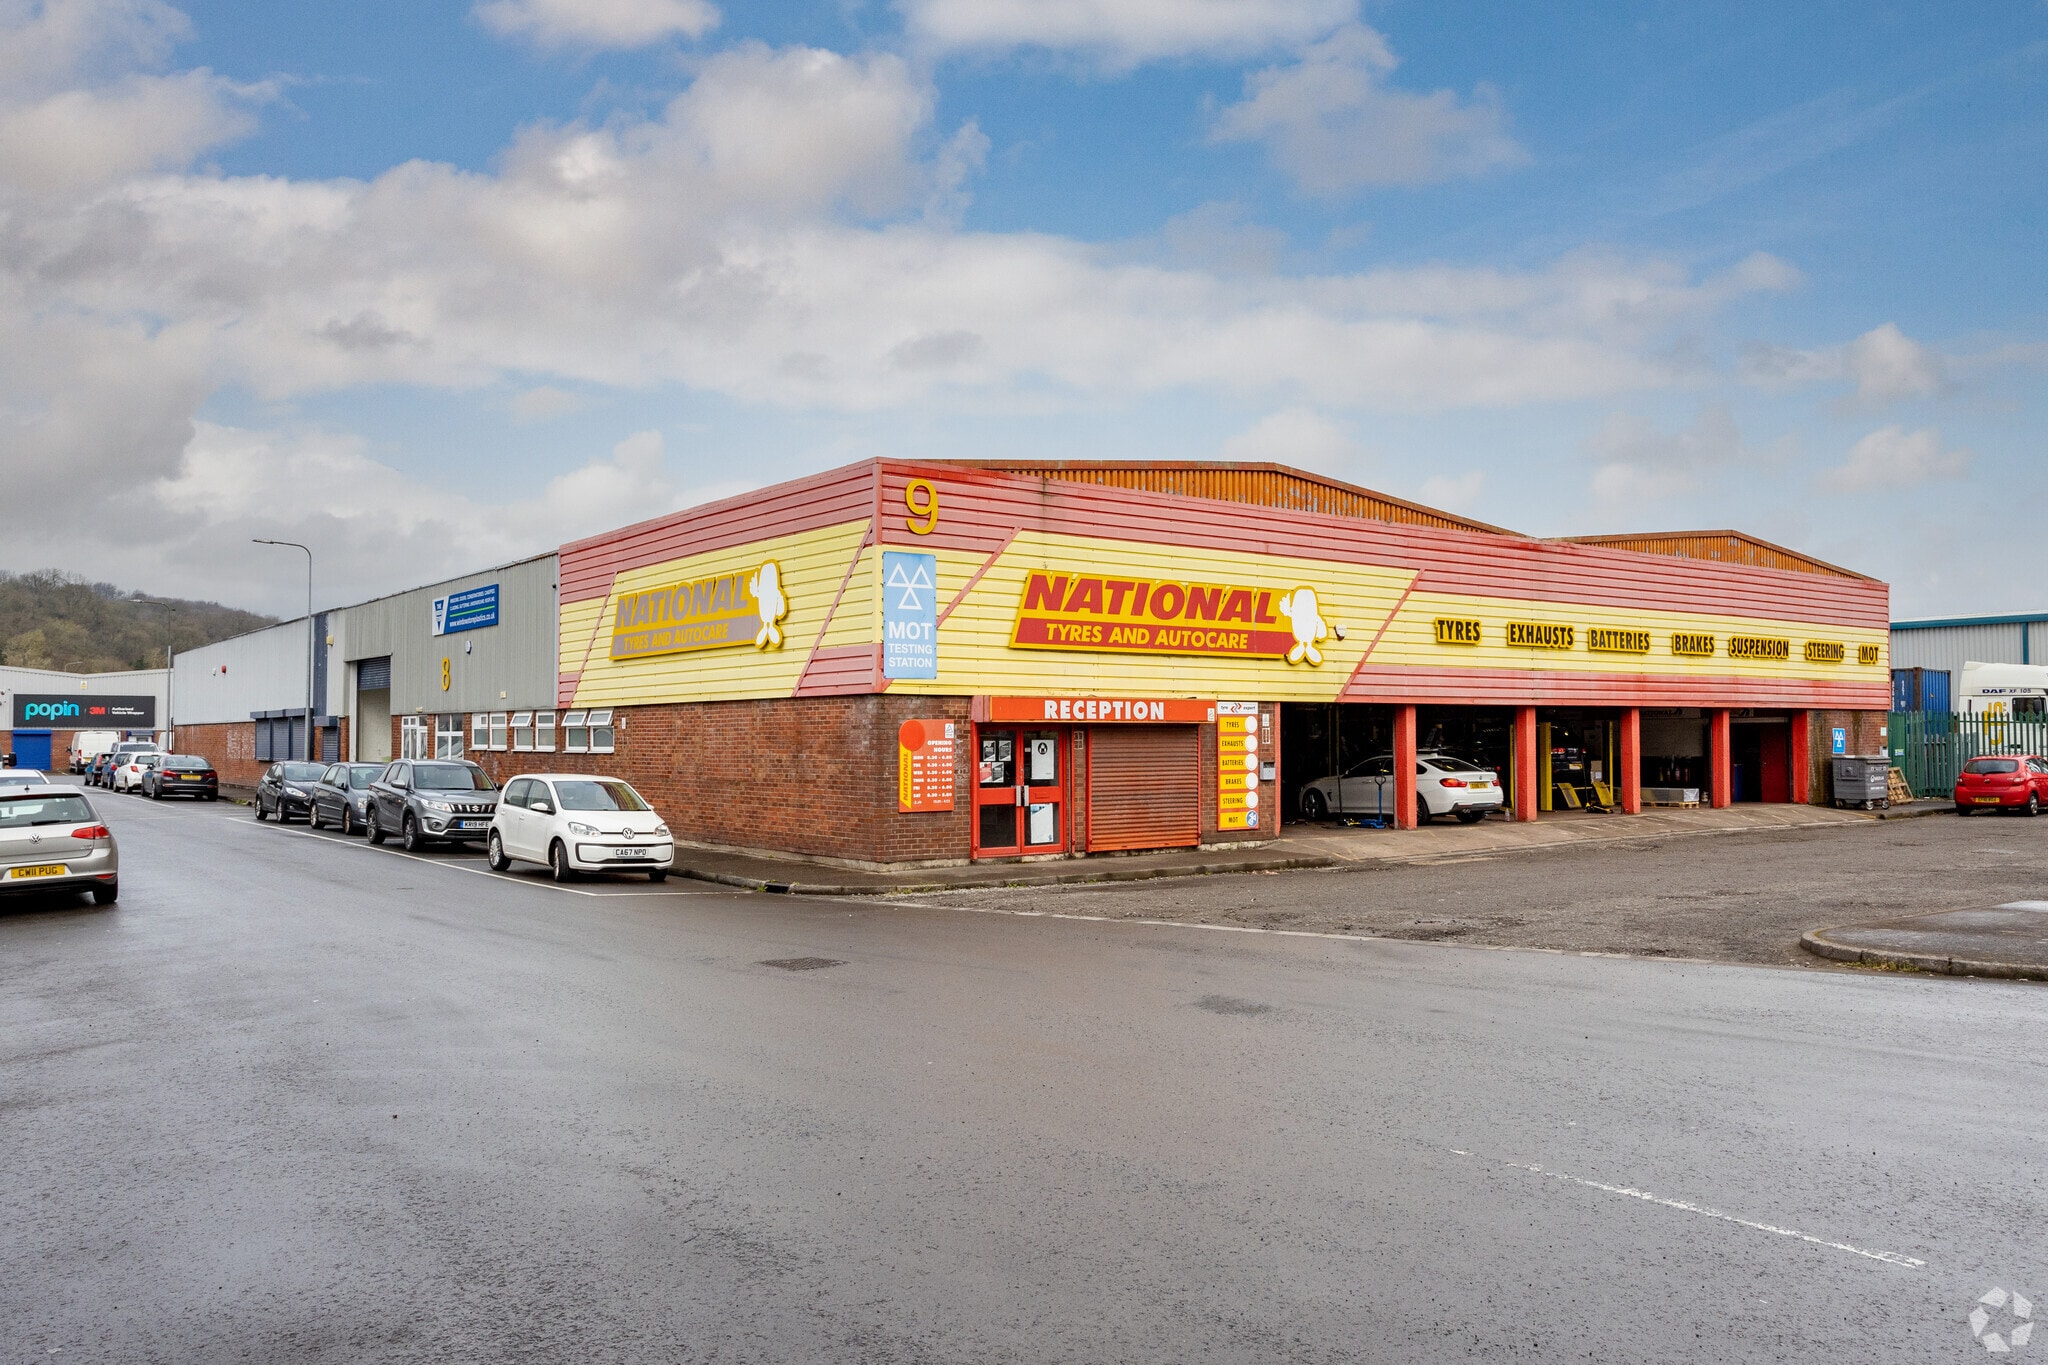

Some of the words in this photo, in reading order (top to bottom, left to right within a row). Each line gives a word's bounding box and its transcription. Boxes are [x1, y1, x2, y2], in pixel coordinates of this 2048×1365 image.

[905, 478, 939, 535] 9
[615, 576, 749, 629] NATIONAL
[1023, 574, 1277, 624] NATIONAL
[623, 635, 649, 651] TYRES
[651, 631, 671, 647] AND
[673, 623, 729, 645] AUTOCARE
[888, 621, 933, 640] MOT
[1046, 622, 1102, 643] TYRES
[1108, 626, 1150, 645] AND
[1155, 628, 1249, 649] AUTOCARE
[1437, 619, 1480, 642] TYRES
[1510, 623, 1574, 646] EXHAUSTS
[1591, 629, 1650, 650] BATTERIES
[888, 643, 933, 655] TESTING
[1675, 634, 1714, 653] BRAKES
[1731, 637, 1789, 657] SUSPENSION
[1807, 642, 1844, 660] STEERING
[888, 657, 933, 668] STATION
[1861, 646, 1879, 662] MOT
[441, 656, 450, 692] 8
[25, 700, 80, 720] popin
[89, 706, 106, 715] 3M
[1044, 699, 1165, 720] RECEPTION
[1222, 797, 1244, 805] STEERING
[615, 848, 633, 856] CA67
[18, 868, 37, 877] CW11
[39, 866, 58, 876] PUG
